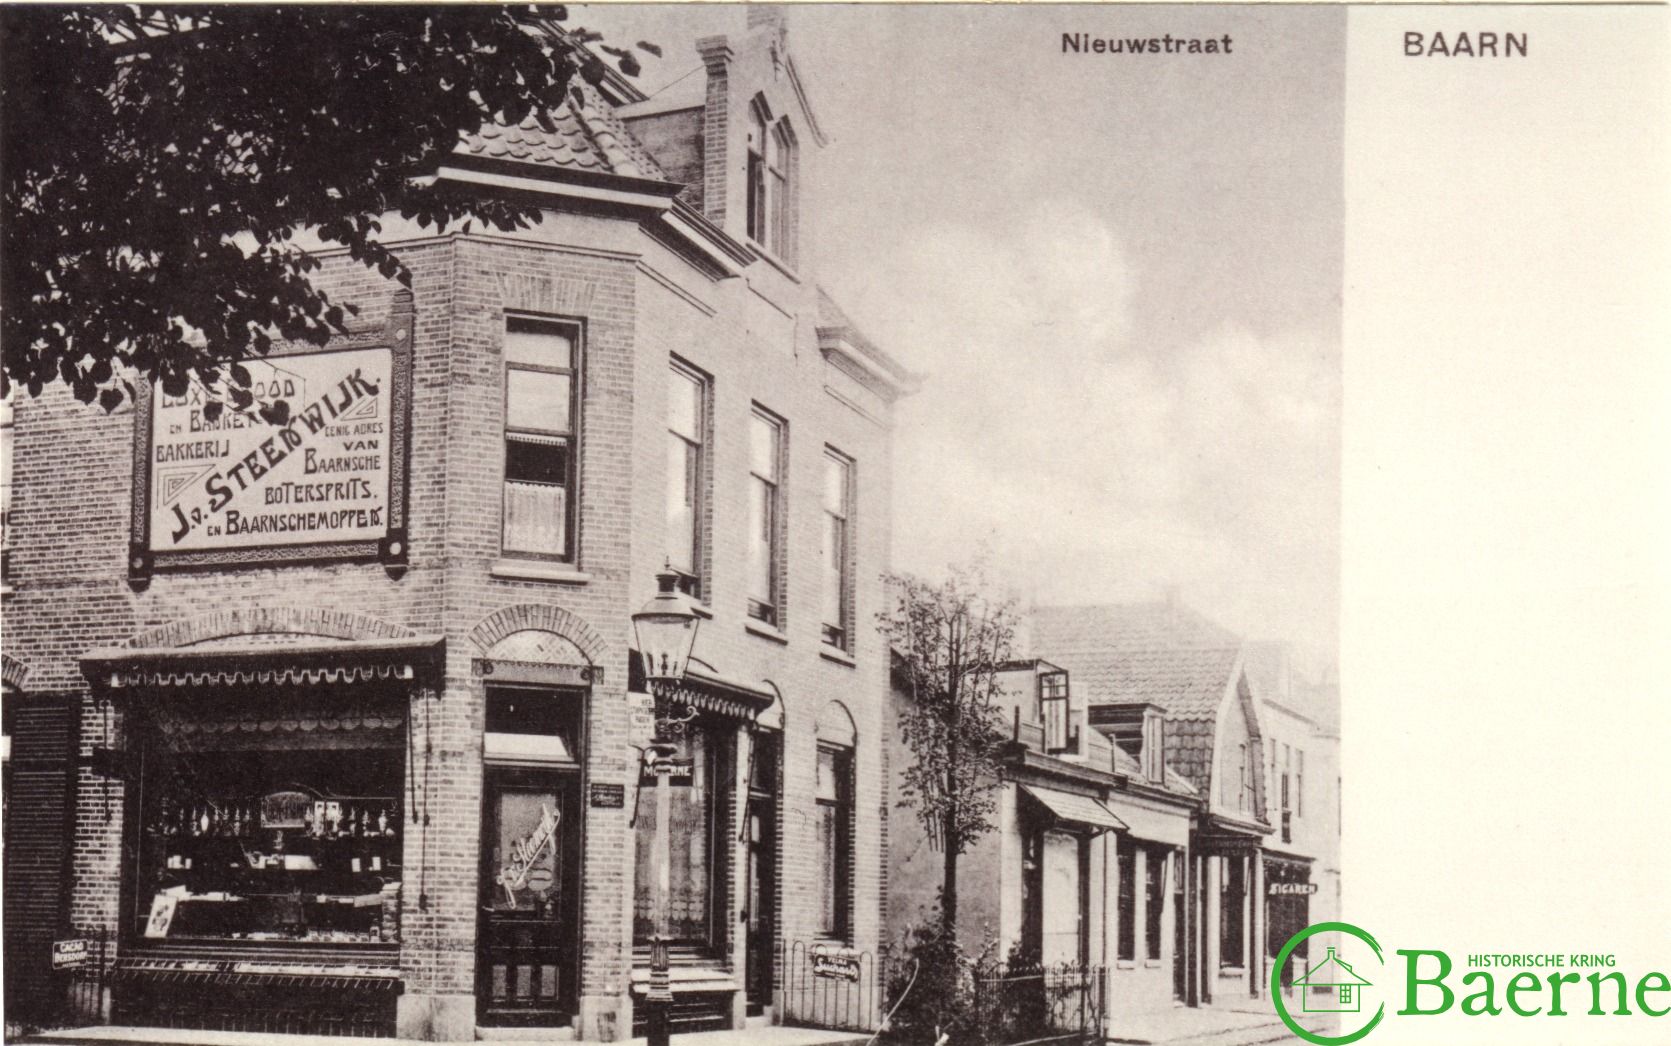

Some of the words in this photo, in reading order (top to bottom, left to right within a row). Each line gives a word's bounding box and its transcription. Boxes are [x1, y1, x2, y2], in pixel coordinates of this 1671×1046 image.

[324, 424, 350, 437] EENIG
[353, 422, 383, 436] ADRES
[156, 439, 230, 462] BAKKERIJ
[343, 440, 378, 451] VAN
[304, 448, 381, 474] BAARNSCHE
[264, 478, 378, 505] BOTERSPRITS.
[207, 525, 221, 536] EN
[643, 765, 692, 777] MORNE
